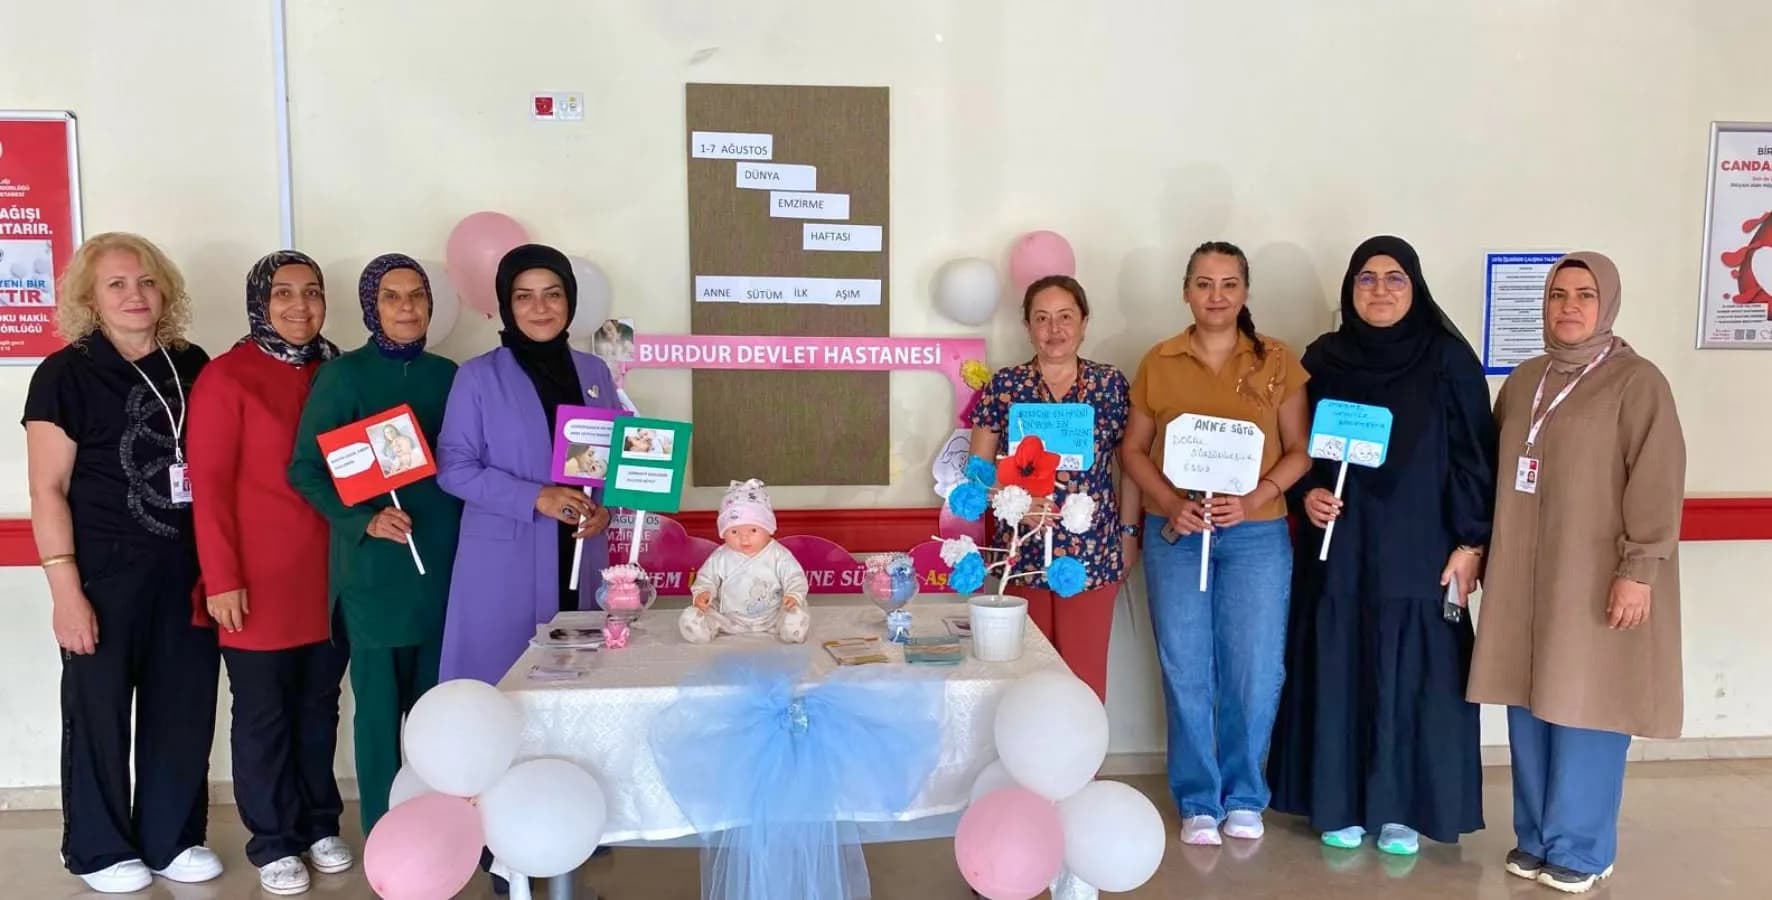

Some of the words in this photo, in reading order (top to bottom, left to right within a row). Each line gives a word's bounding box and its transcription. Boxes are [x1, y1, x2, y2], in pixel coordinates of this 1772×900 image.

[700, 144, 716, 153] 1-7
[721, 143, 768, 155] AĞUSTOS
[744, 170, 780, 181] DÜNYA
[778, 198, 825, 209] EMZİRME
[810, 231, 851, 242] HAFTASI
[26, 279, 46, 288] BİR
[703, 288, 731, 298] ANNE
[747, 288, 783, 300] SÜTÜM
[794, 288, 808, 298] İLK
[835, 289, 860, 301] AŞIM
[19, 312, 50, 322] NAKİL
[639, 343, 732, 363] BURDUR
[737, 344, 819, 364] DEVLET
[824, 343, 941, 365] HASTANESİ
[1193, 419, 1227, 433] ANNE
